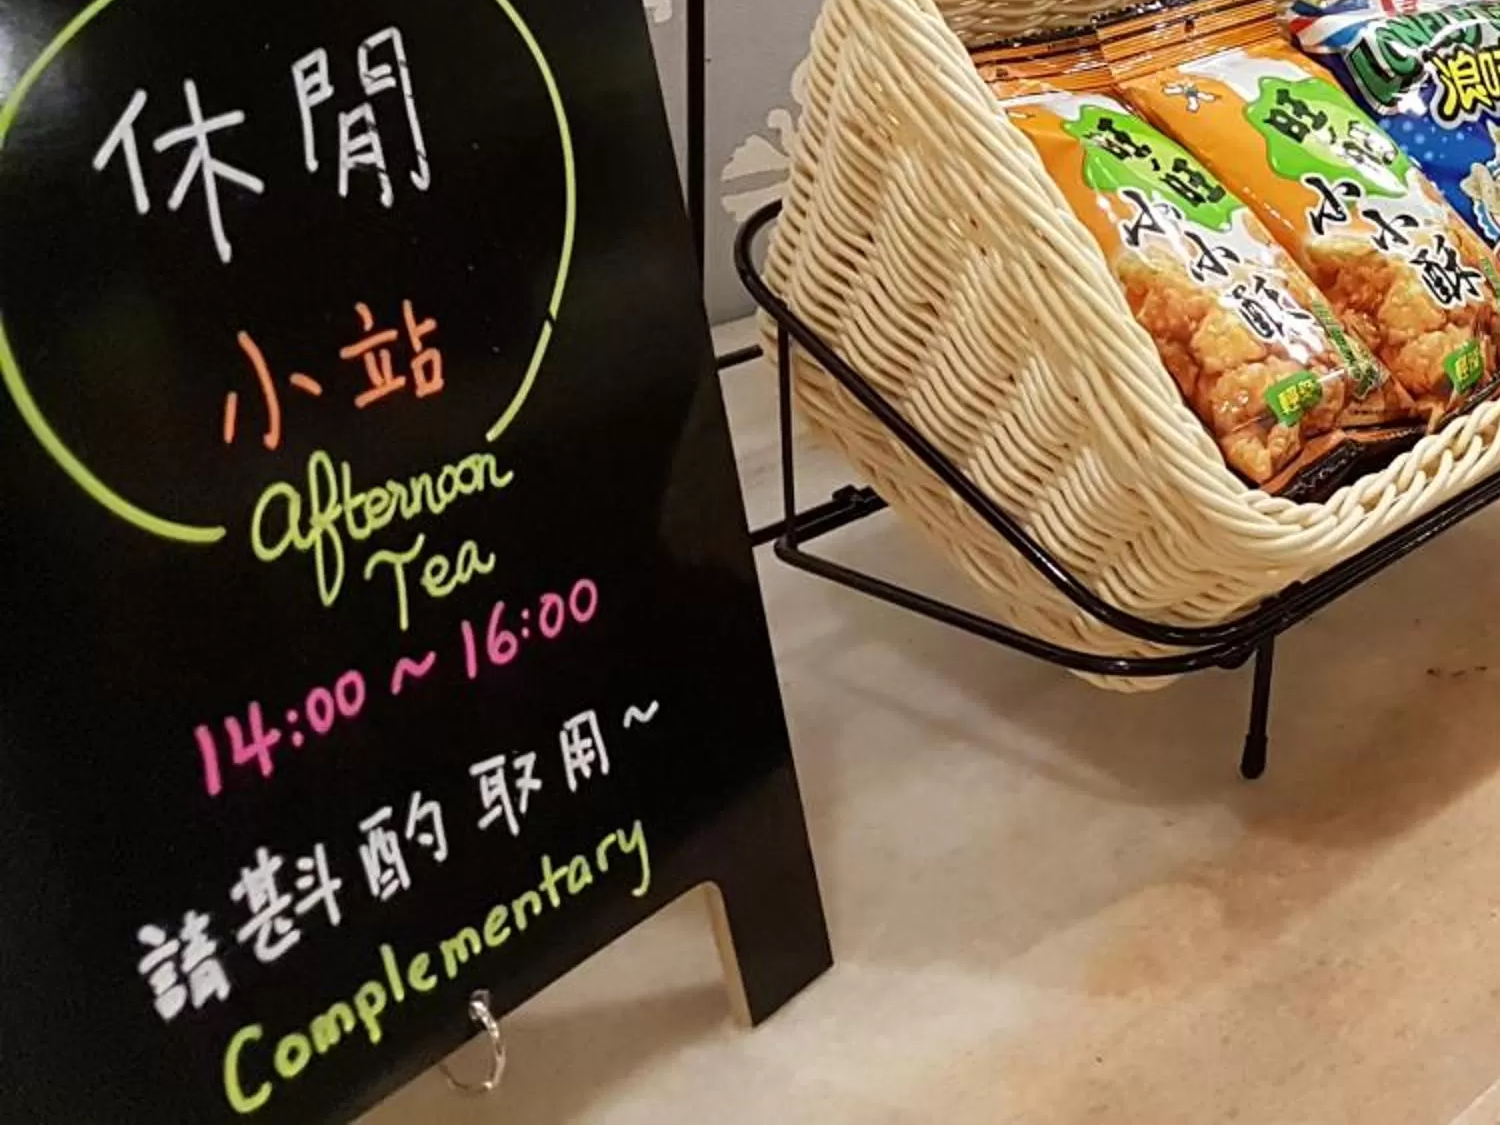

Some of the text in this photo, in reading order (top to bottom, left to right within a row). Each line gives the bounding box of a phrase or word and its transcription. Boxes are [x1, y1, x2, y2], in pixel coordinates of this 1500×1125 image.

[1303, 175, 1482, 305] 小小酥
[222, 298, 445, 450] 小站
[363, 533, 497, 633] Tea
[222, 818, 651, 1115] Complementary
